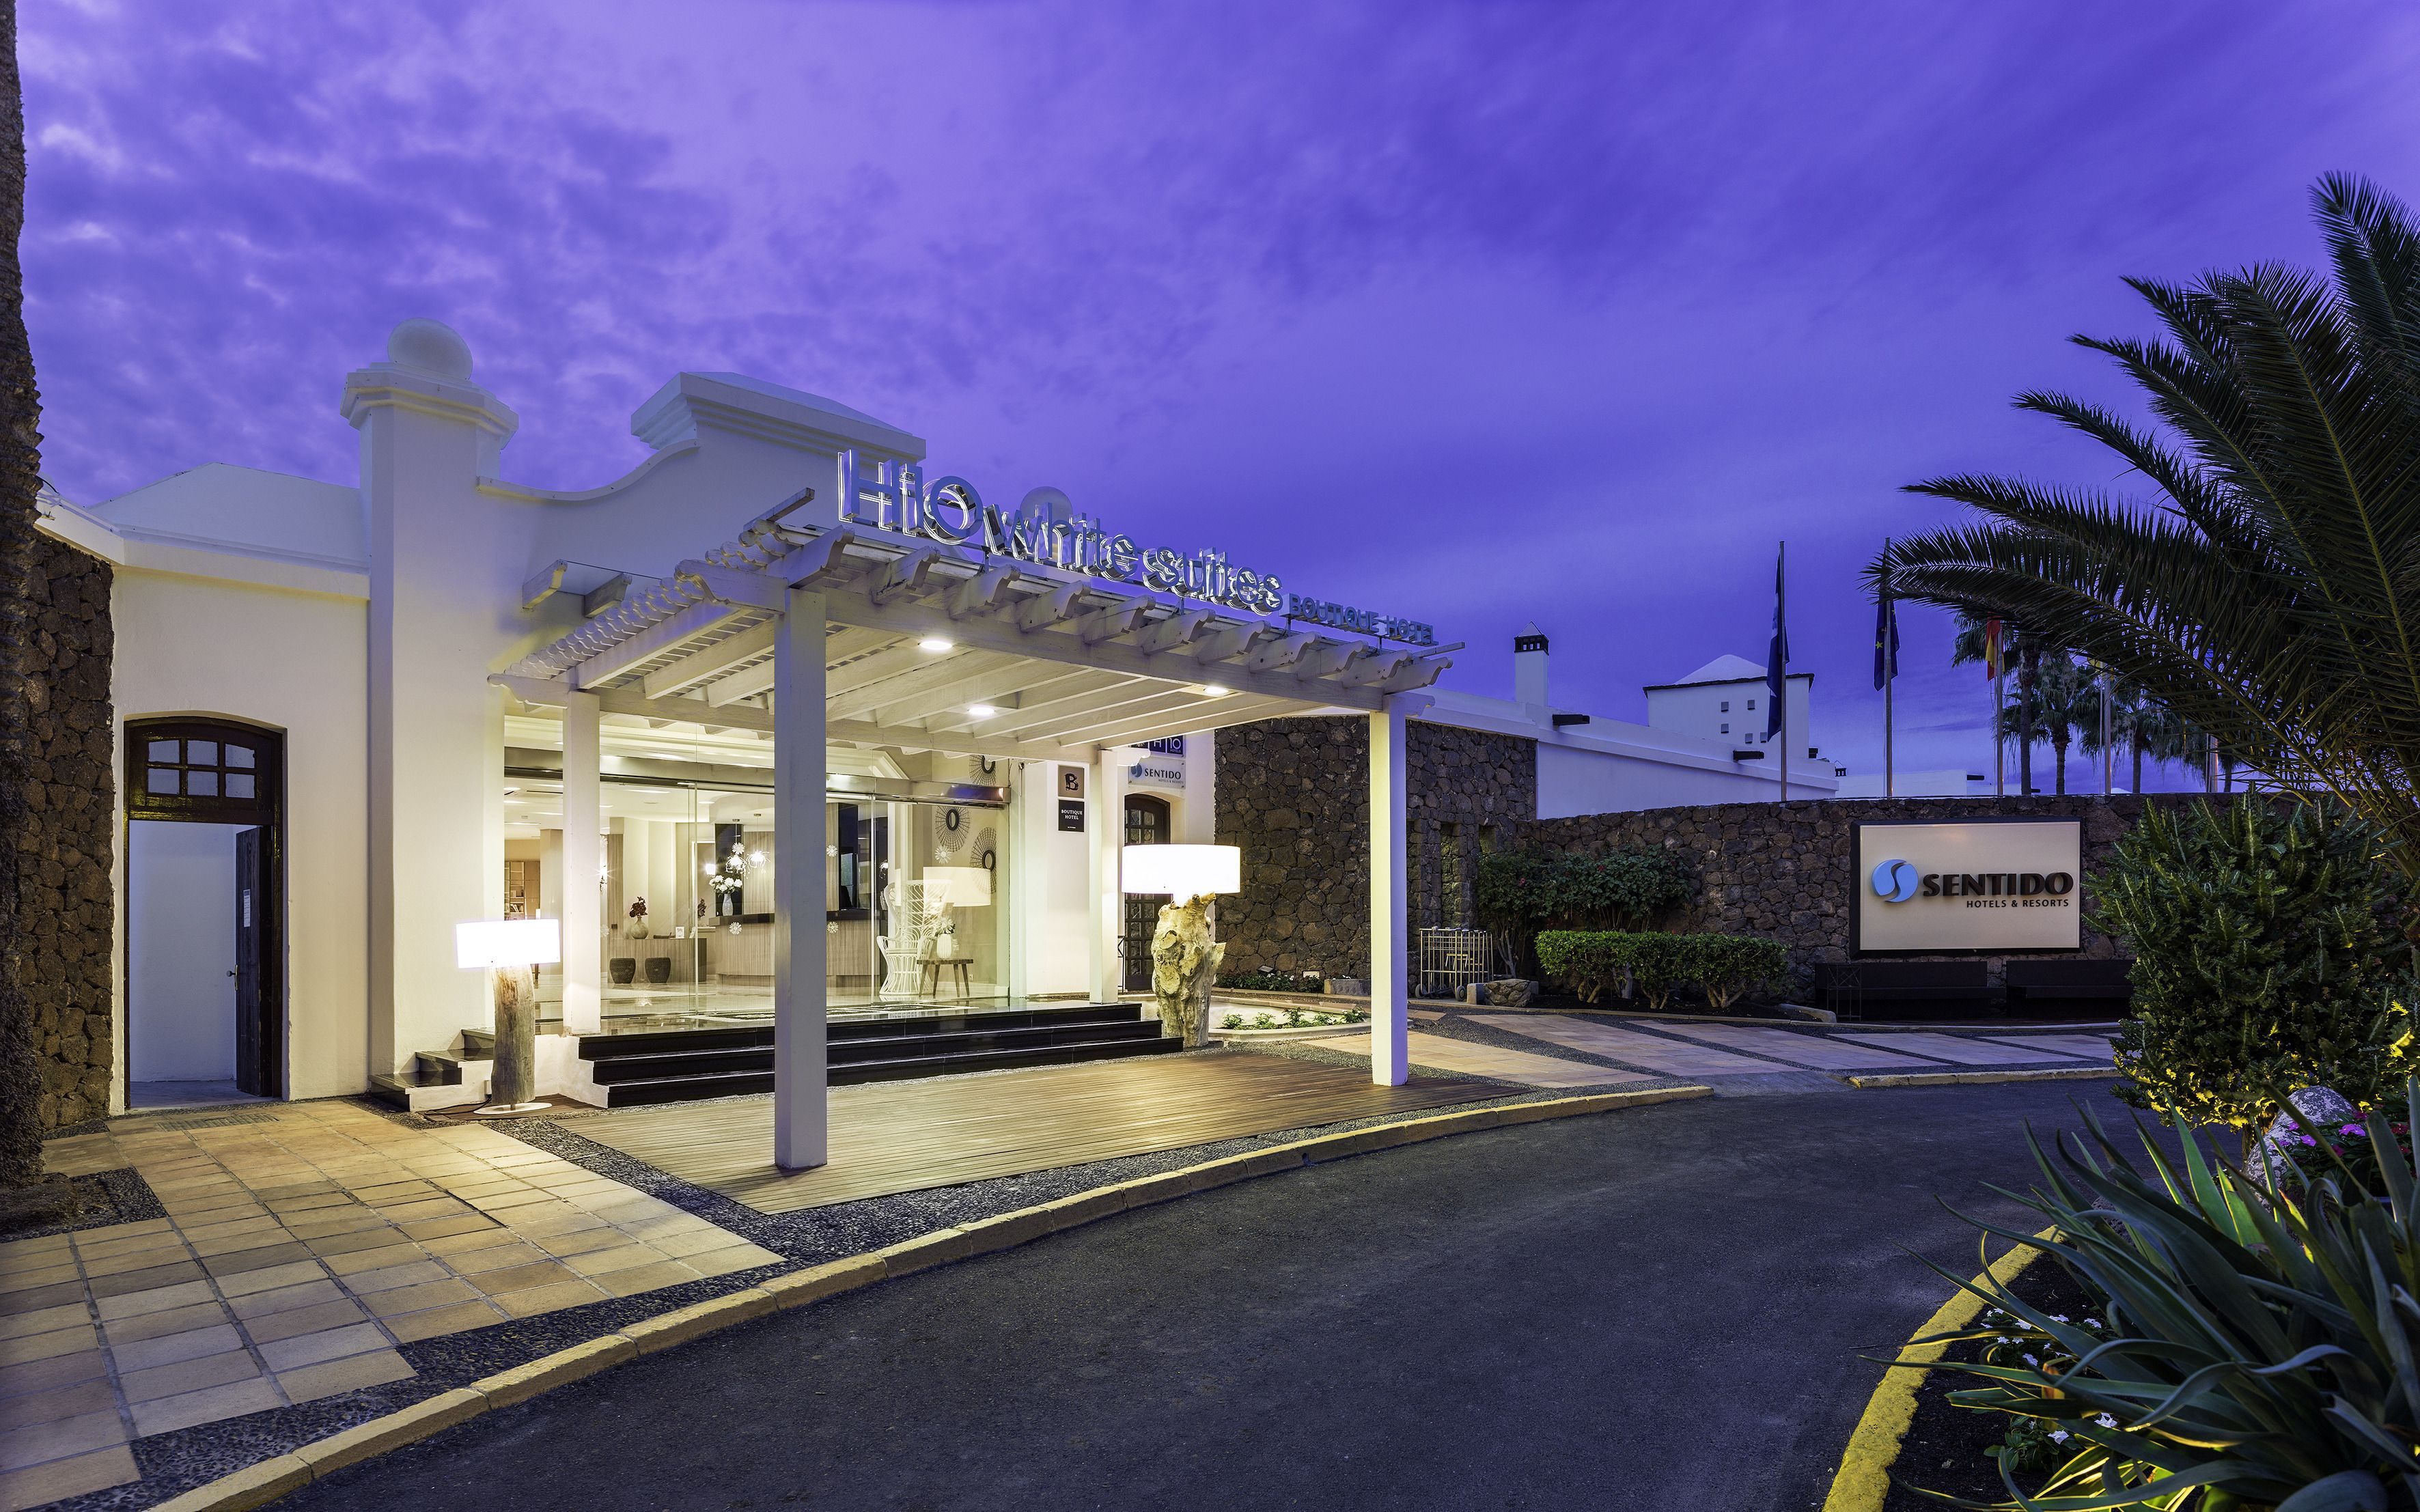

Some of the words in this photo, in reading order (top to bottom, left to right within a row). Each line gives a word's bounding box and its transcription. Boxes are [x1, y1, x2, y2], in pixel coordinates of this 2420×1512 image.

[1283, 593, 1380, 633] BOUTIQUE
[1385, 615, 1437, 646] HOTEL
[1064, 773, 1079, 791] B
[1144, 768, 1182, 780] SENTIDO
[1923, 872, 2074, 897] SENTIDO
[1966, 899, 2007, 908] HOTELS
[2011, 899, 2018, 908] &
[2022, 899, 2070, 908] RESORTS
